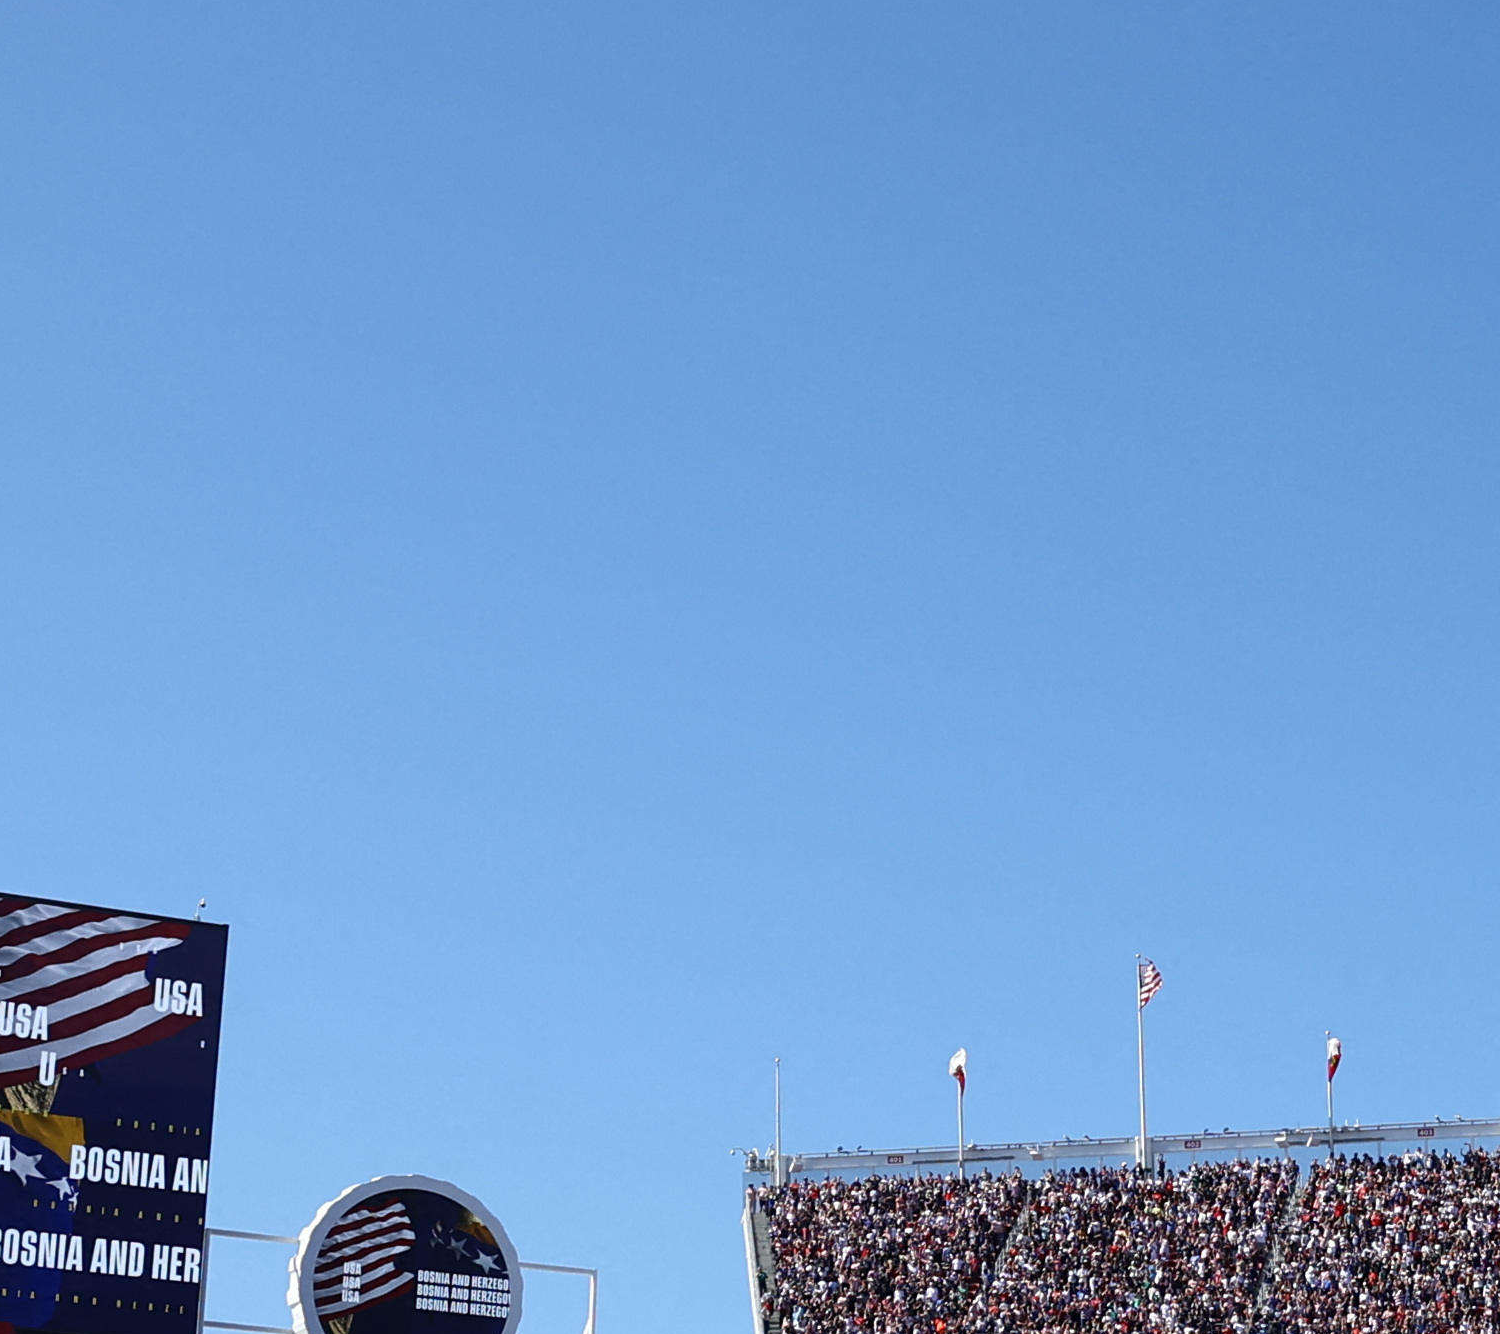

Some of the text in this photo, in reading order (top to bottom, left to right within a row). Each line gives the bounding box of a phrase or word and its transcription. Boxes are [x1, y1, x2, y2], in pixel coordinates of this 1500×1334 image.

[154, 978, 202, 1017] USA
[69, 1144, 208, 1194] BOSNIA AN
[90, 1238, 144, 1277] AND
[151, 1244, 201, 1283] HER
[344, 1262, 361, 1275] USA
[343, 1276, 360, 1289] USA
[418, 1270, 450, 1284] BOSNIA
[452, 1274, 469, 1286] AND
[342, 1290, 359, 1303] USA
[417, 1283, 449, 1298] BOSNIA
[451, 1287, 469, 1300] AND
[416, 1297, 448, 1312] BOSNIA
[450, 1301, 468, 1314] AND
